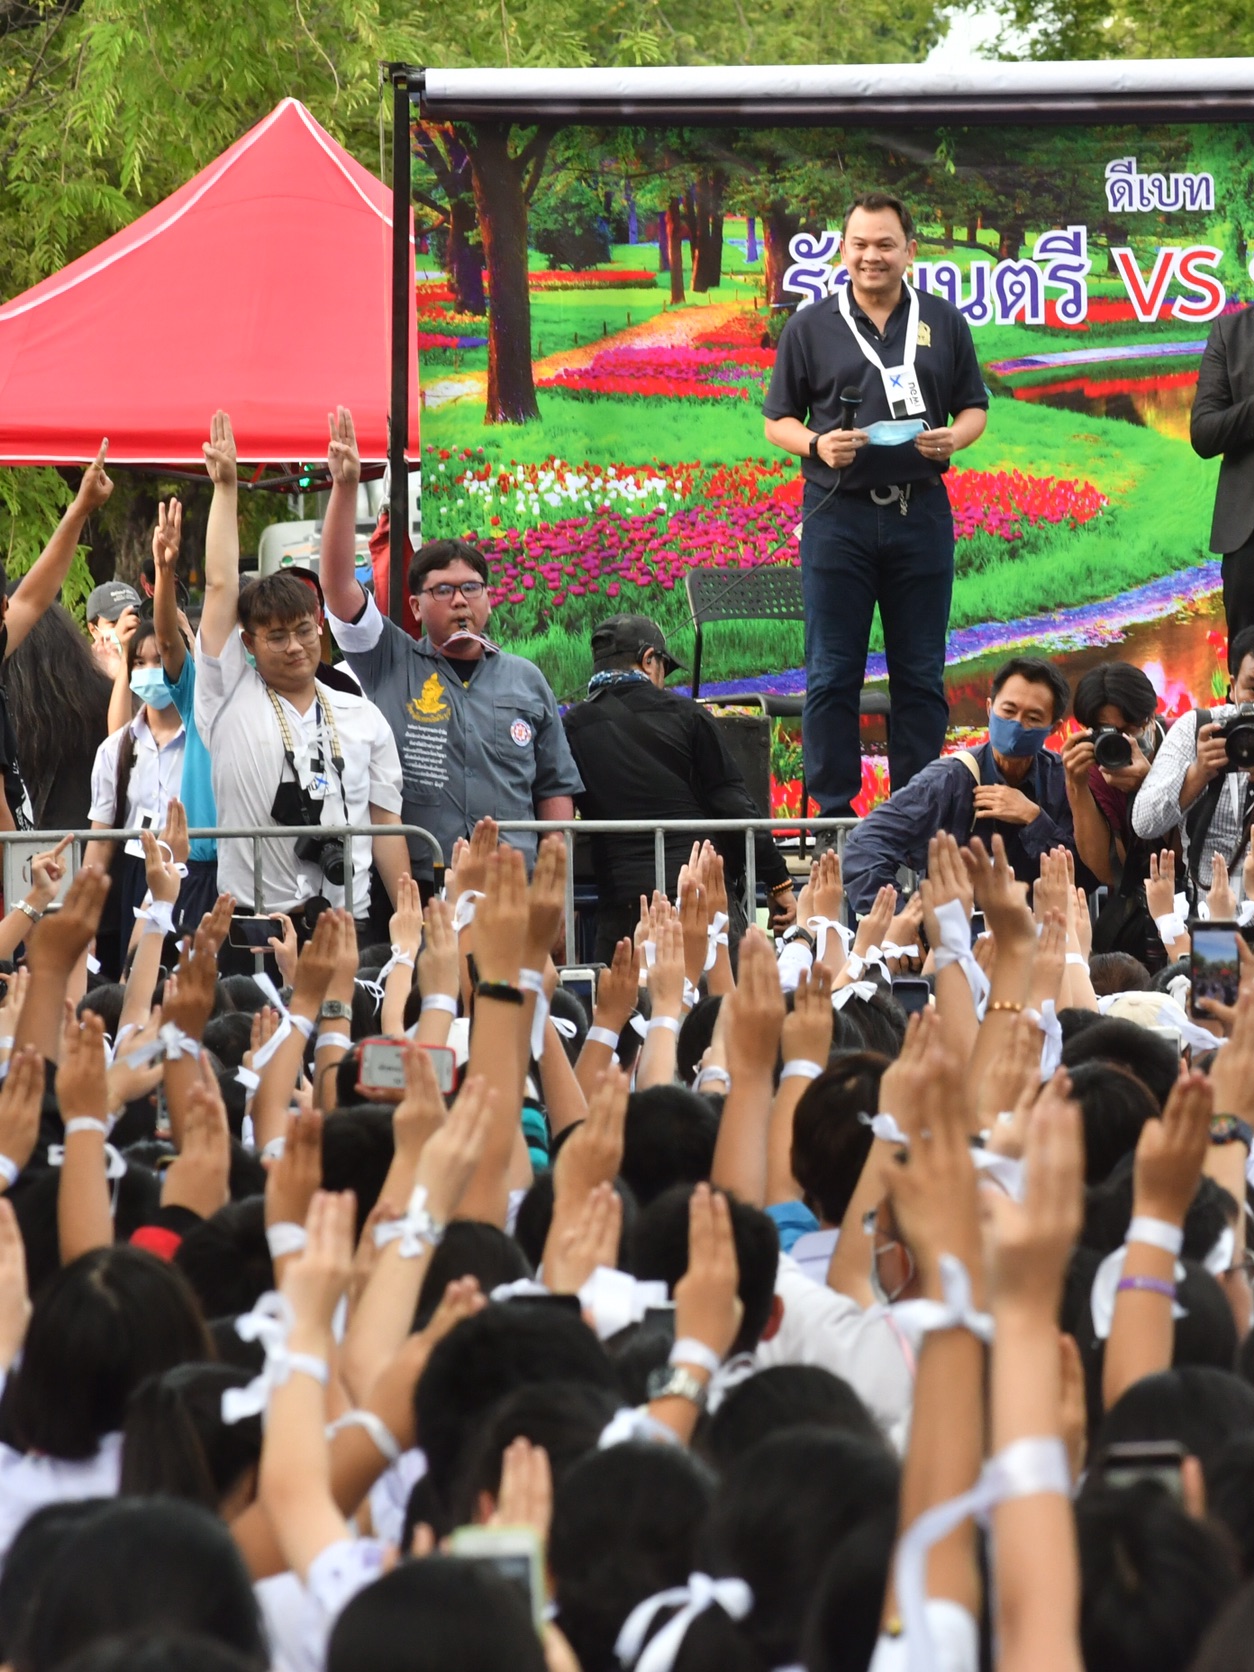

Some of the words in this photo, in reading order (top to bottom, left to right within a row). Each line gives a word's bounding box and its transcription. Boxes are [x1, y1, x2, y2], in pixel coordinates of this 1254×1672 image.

[1105, 157, 1215, 212] ดีเบท
[783, 225, 1092, 326] รันตรี
[1110, 245, 1226, 322] VS
